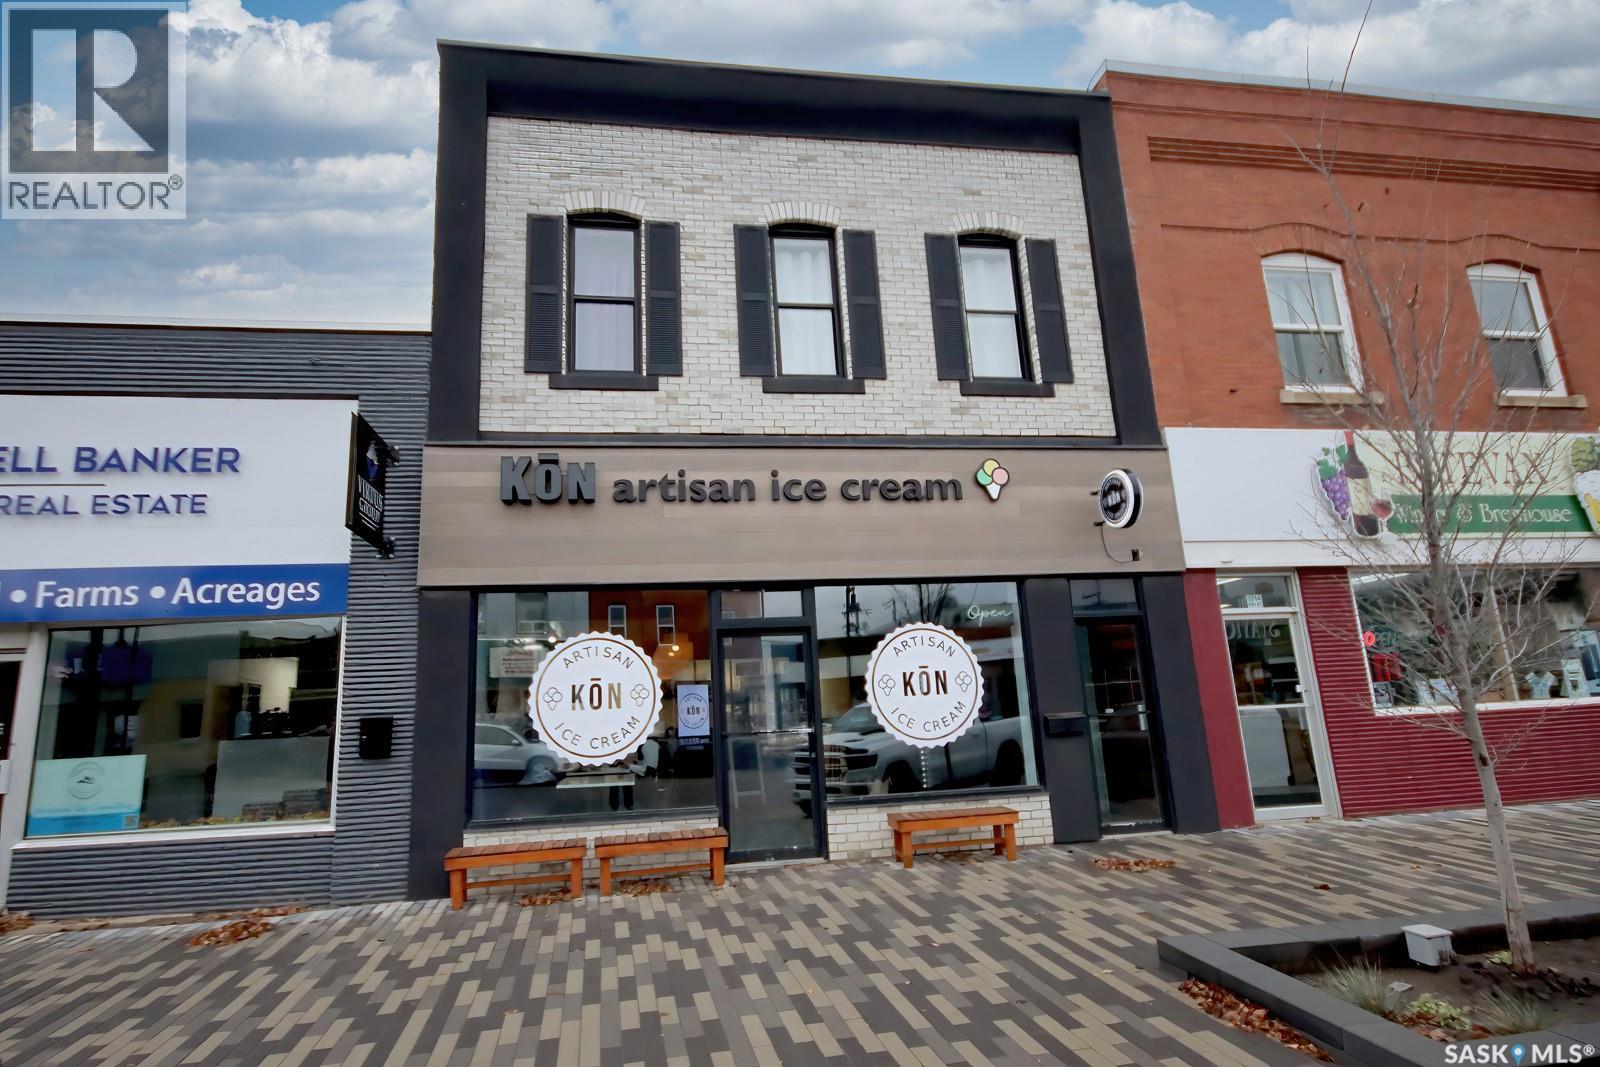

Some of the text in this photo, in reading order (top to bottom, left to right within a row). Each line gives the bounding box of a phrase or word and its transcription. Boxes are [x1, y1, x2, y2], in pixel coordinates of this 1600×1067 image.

[74, 447, 241, 473] BANKER
[612, 469, 756, 503] artisan
[770, 469, 828, 502] ice
[840, 478, 963, 502] cream
[91, 494, 209, 516] ESTATE
[35, 577, 321, 611] Farms Acreages
[561, 646, 635, 670] ARTISAN
[892, 635, 957, 658] ARTISAN
[891, 701, 967, 733] ICE CREAM
[554, 715, 641, 750] ICE CREAM
